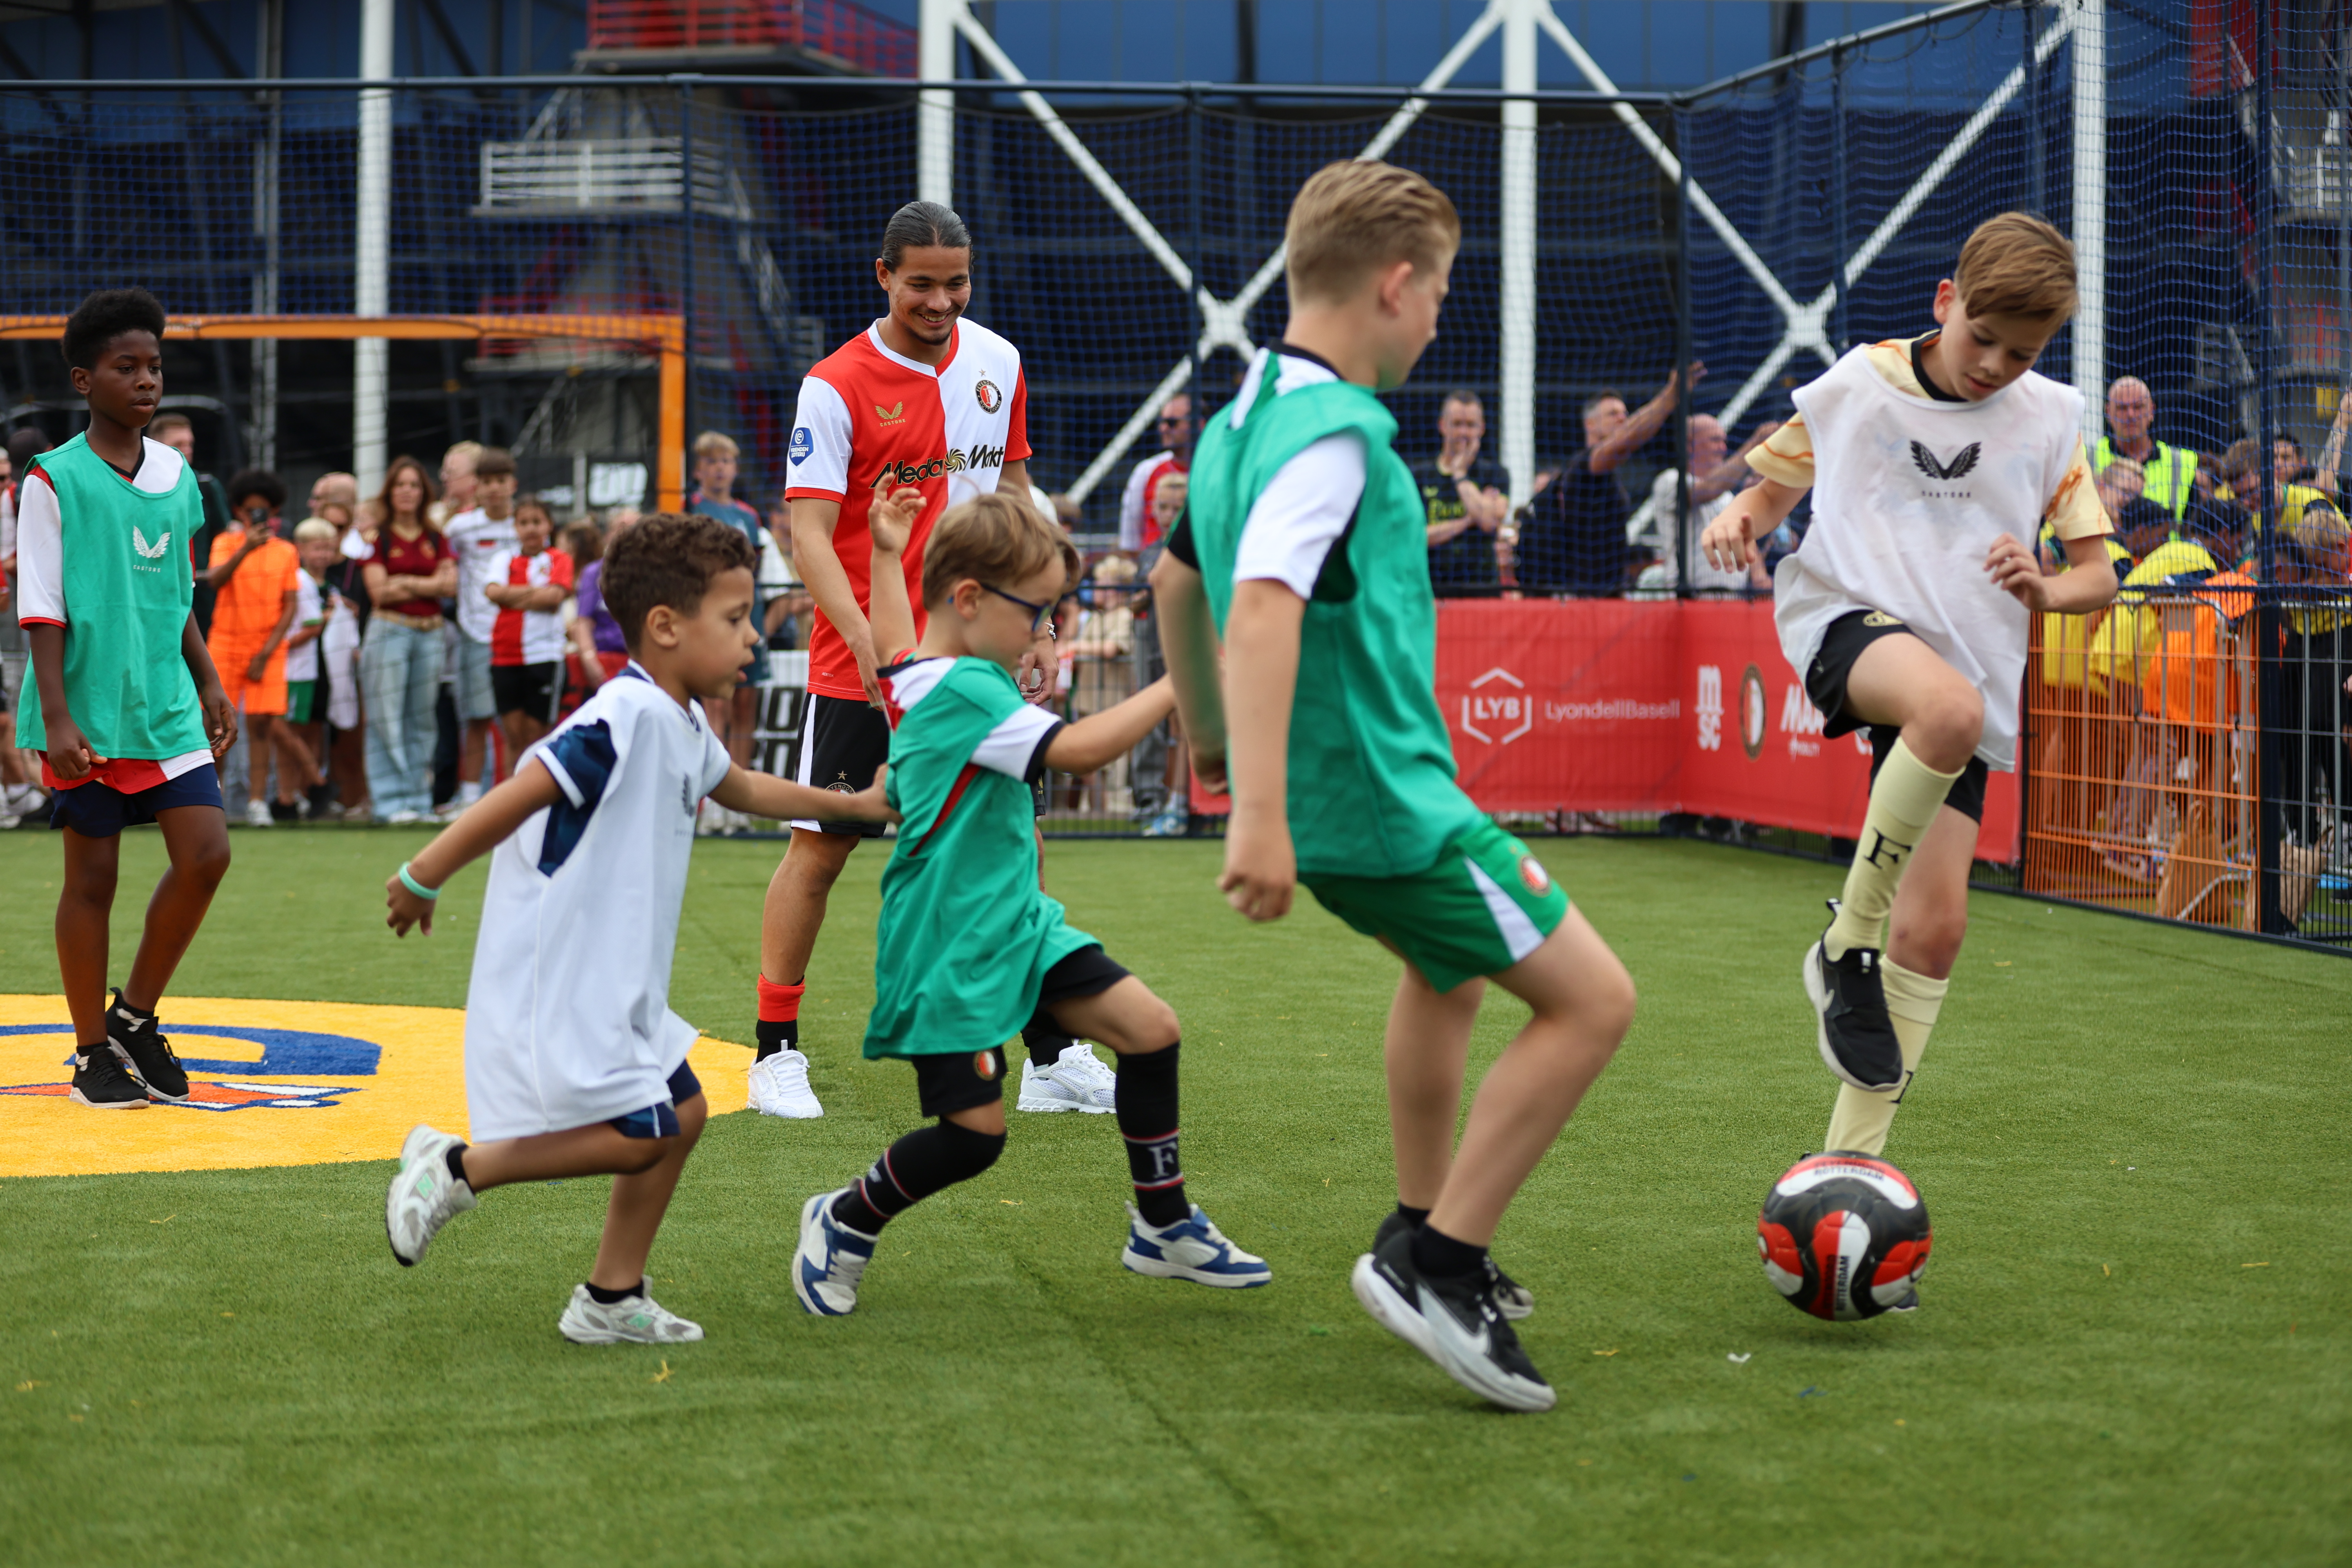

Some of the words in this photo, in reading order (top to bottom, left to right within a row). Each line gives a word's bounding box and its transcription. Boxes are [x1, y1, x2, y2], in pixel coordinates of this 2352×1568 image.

[976, 381, 999, 392] FEYENOORD
[980, 400, 1001, 413] ROTTERDAM
[880, 419, 906, 427] CASTORE
[869, 457, 944, 489] Media
[1475, 697, 1521, 719] LYB
[1545, 697, 1680, 722] LyondellBasell
[827, 784, 853, 795] EYENOOR
[1147, 1141, 1178, 1178] F
